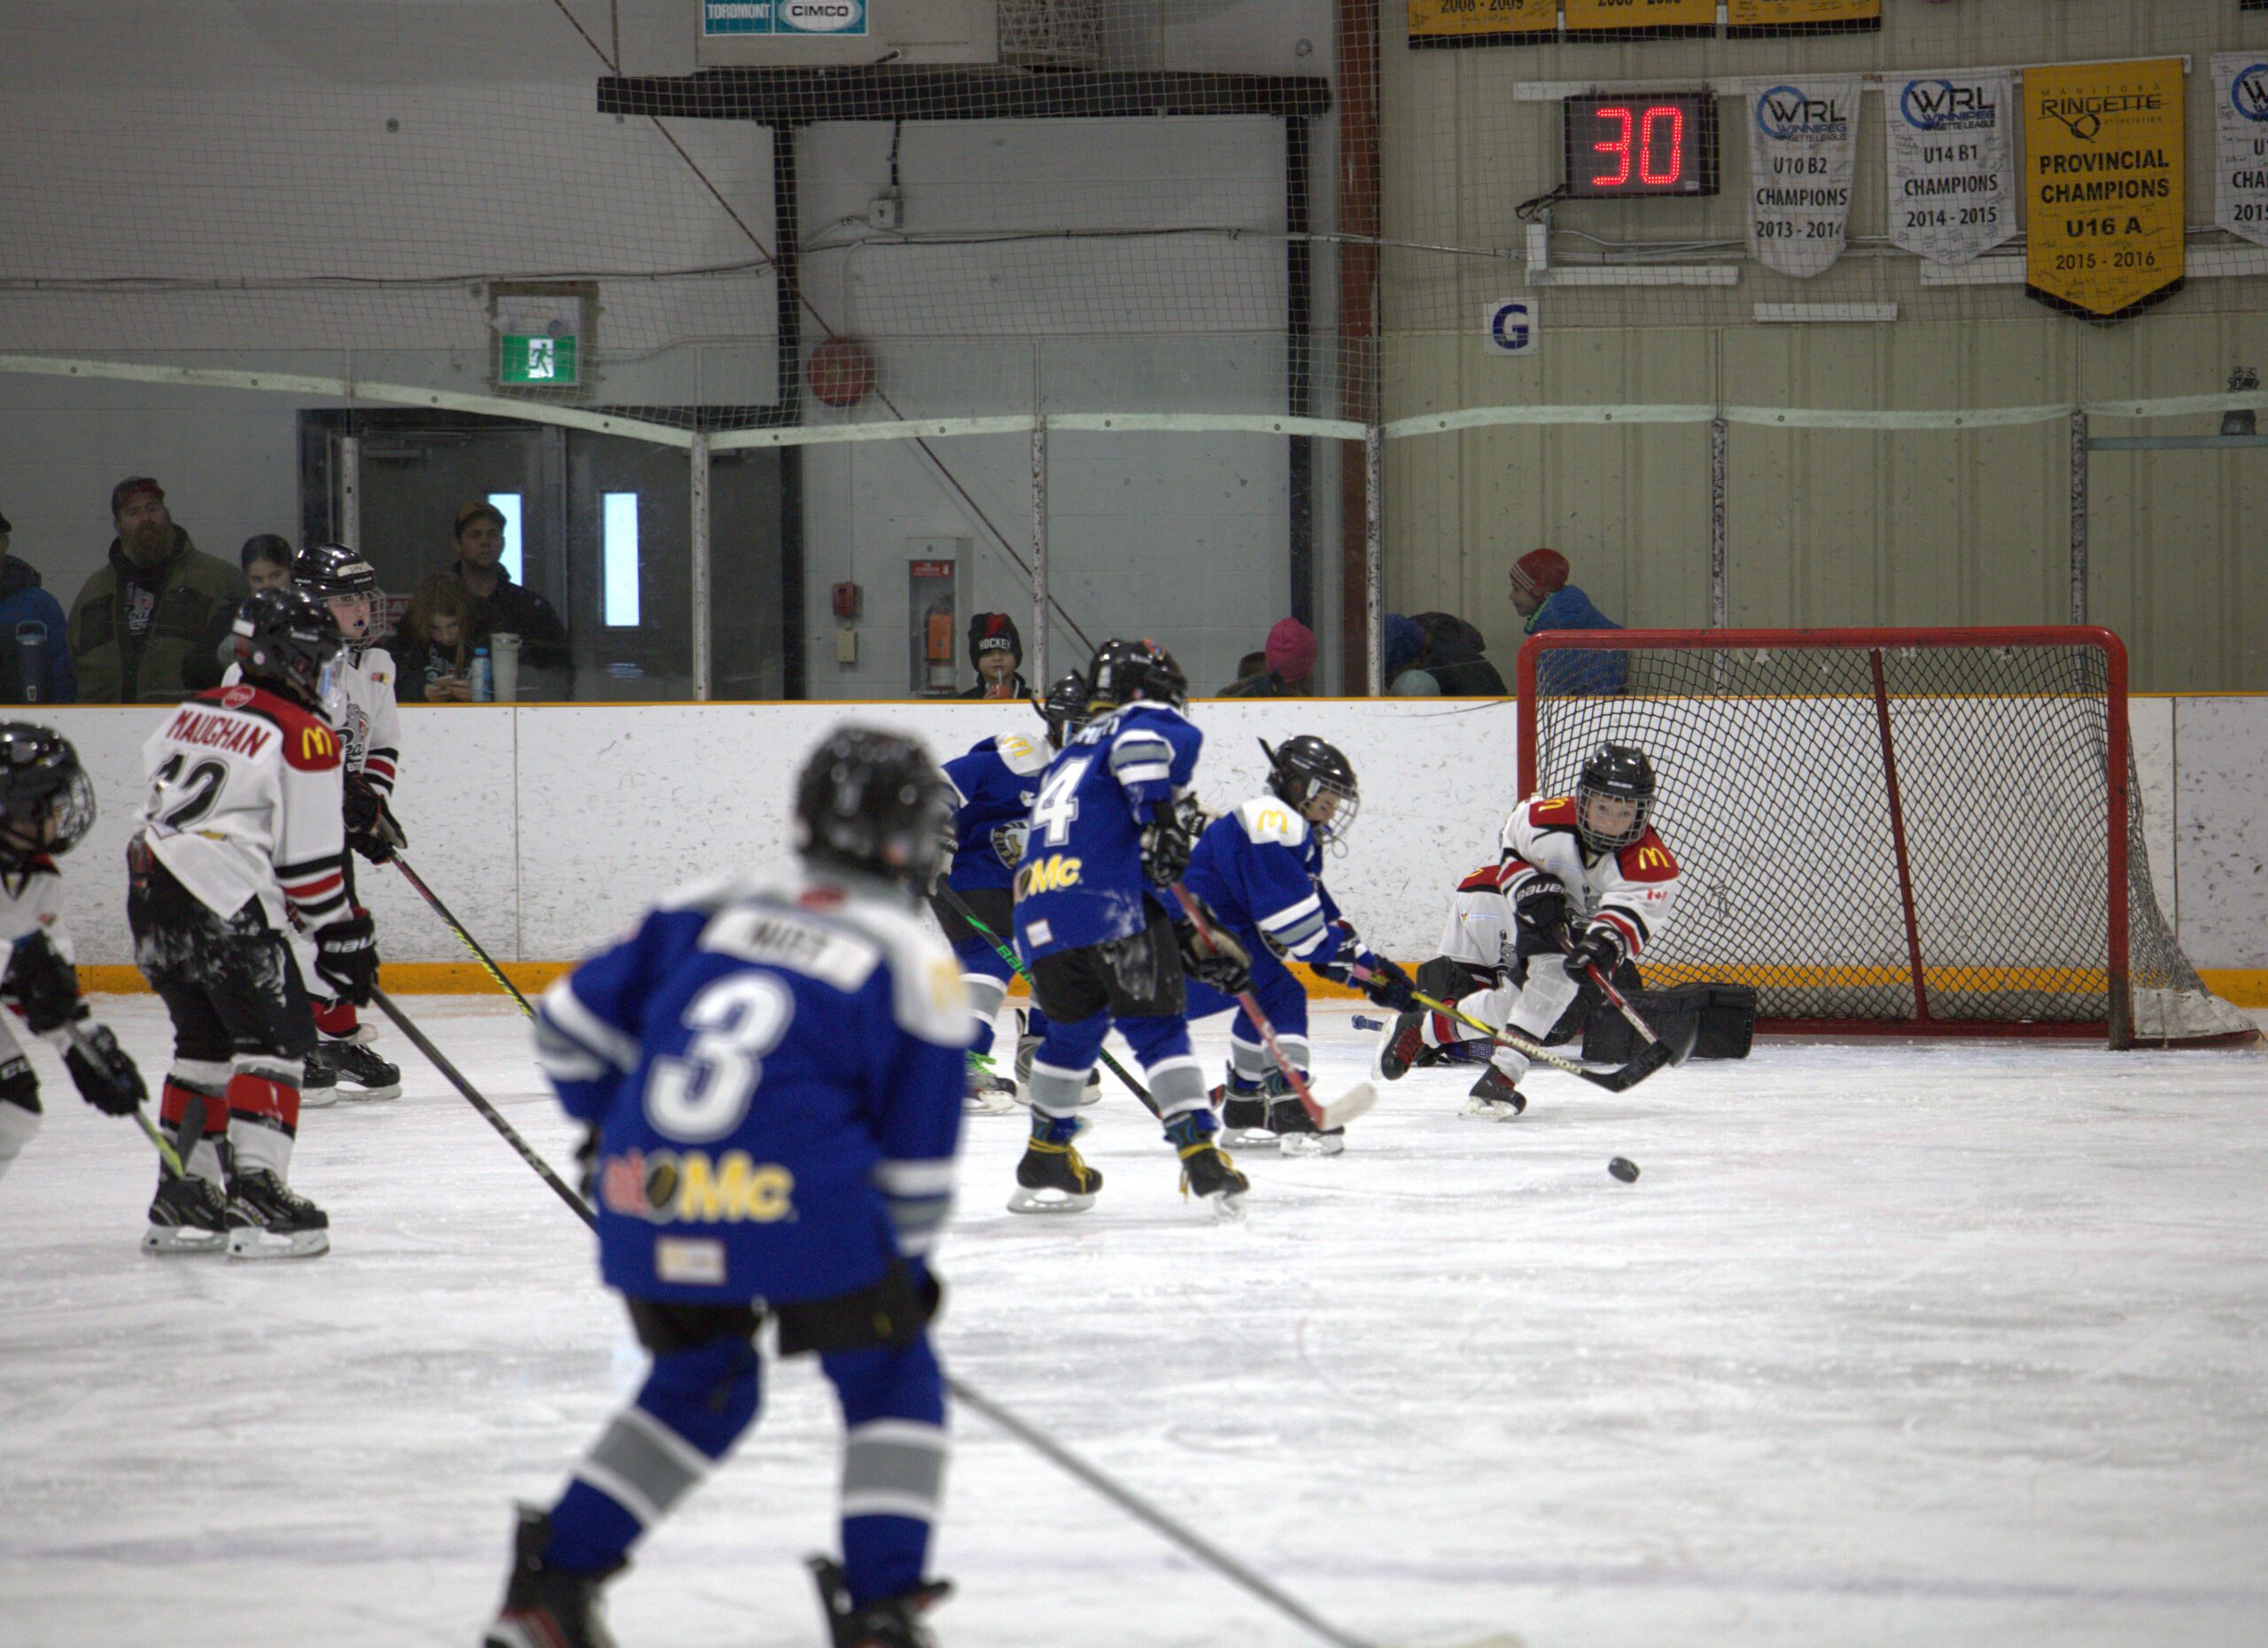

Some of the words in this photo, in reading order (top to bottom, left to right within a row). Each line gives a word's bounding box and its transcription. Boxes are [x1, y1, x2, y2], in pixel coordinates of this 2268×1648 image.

[706, 4, 771, 19] TOROMONT
[791, 5, 849, 17] CIMCO
[2041, 83, 2160, 97] MANITOBA
[1911, 87, 1996, 113] WRL
[2041, 94, 2162, 116] RINGETTE
[1767, 99, 1847, 123] WRL
[1922, 109, 1996, 121] WINNIPEG
[1775, 122, 1847, 134] WINNIPEG
[1963, 119, 1996, 129] LEAGUE
[1592, 106, 1682, 186] 30
[1815, 133, 1847, 142] LEAGUE
[1924, 145, 1953, 163] U14
[1959, 144, 1977, 161] B1
[2039, 149, 2170, 175] PROVINCIAL
[1774, 157, 1804, 175] U10
[1808, 157, 1827, 175] B2
[1905, 175, 1998, 196] CHAMPIONS
[2040, 178, 2170, 204] CHAMPIONS
[1756, 188, 1848, 206] CHAMPIONS
[1907, 210, 1946, 228] 2014
[1960, 206, 1997, 224] 2015
[2066, 217, 2116, 237] U16
[2124, 216, 2143, 235] A
[1757, 222, 1792, 238] 2013
[2056, 253, 2096, 270] 2015
[2114, 251, 2155, 267] 2016
[1492, 304, 1529, 350] G
[978, 637, 1012, 652] HOCKEY
[165, 709, 271, 758] MAUGHAN
[642, 969, 797, 1145] 3
